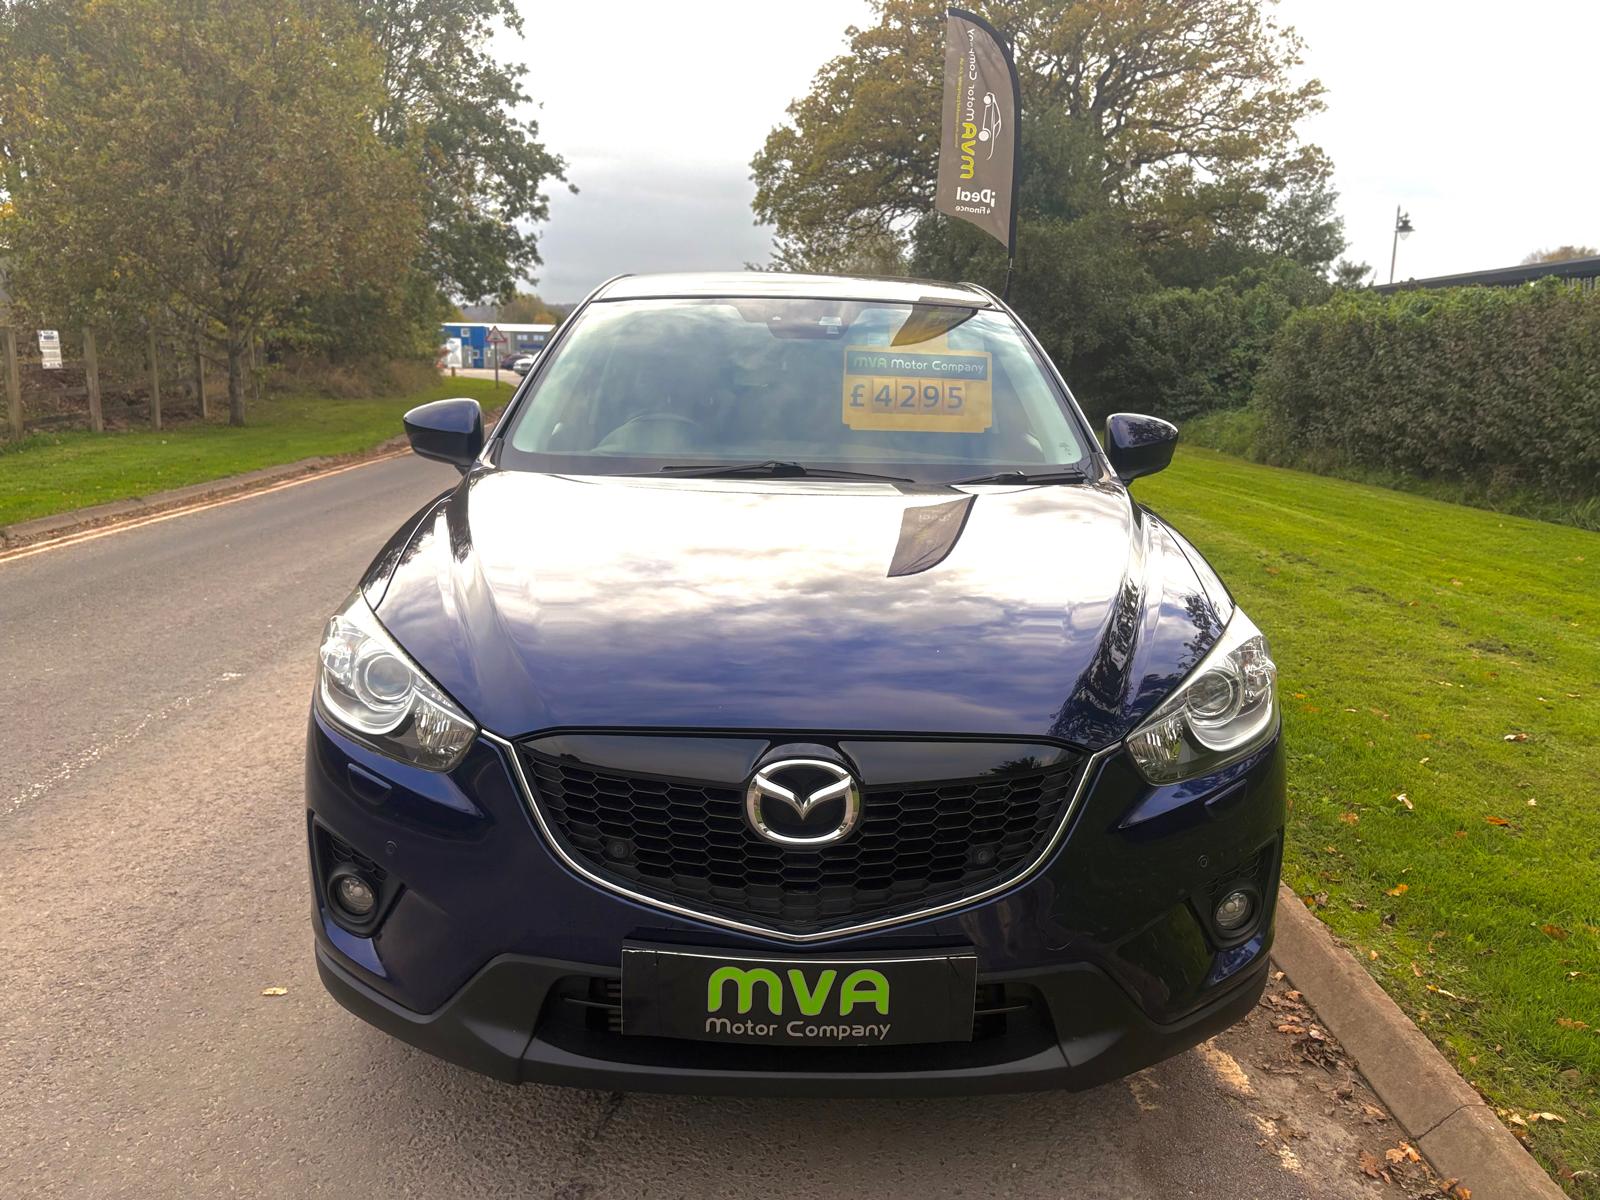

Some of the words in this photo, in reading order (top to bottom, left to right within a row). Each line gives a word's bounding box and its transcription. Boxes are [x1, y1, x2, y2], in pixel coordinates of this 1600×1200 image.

[891, 358, 928, 370] Motor
[932, 360, 984, 373] Company
[707, 966, 890, 1017] MVA
[705, 1017, 778, 1036] Motor
[786, 1020, 891, 1040] Company
